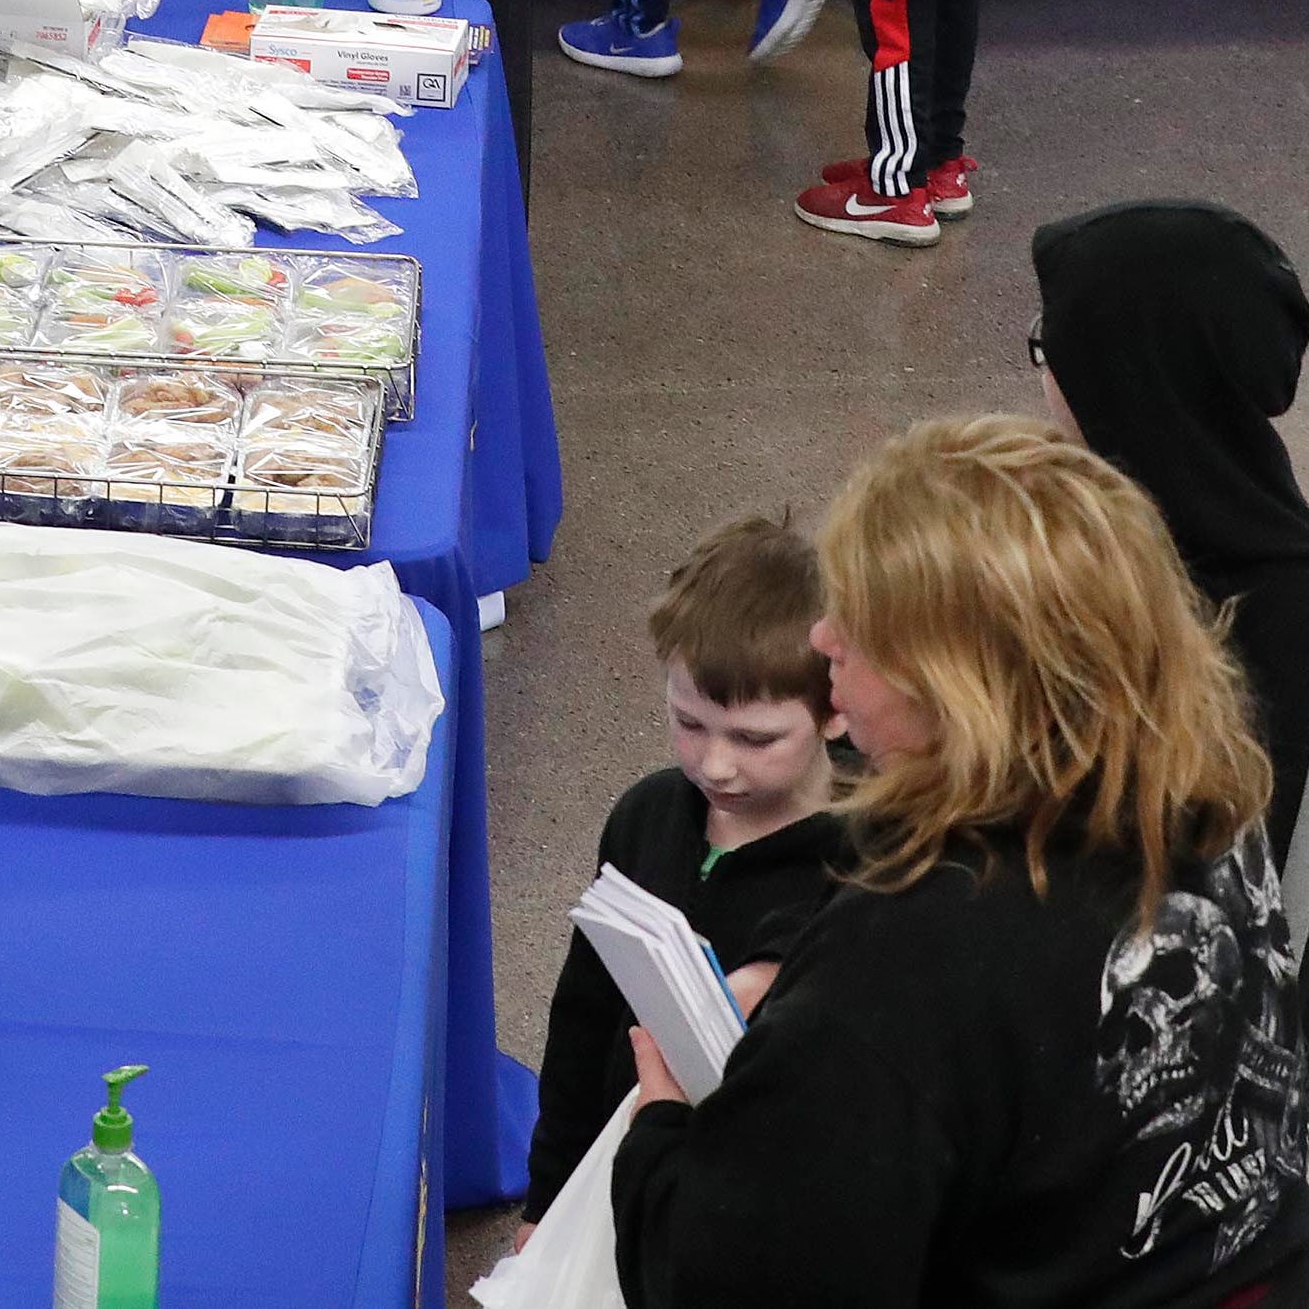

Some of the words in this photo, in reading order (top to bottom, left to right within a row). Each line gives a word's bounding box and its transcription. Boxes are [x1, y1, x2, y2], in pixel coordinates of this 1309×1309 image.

[268, 43, 298, 57] Sysco
[337, 50, 359, 63] Vinyl
[361, 51, 389, 63] Gloves
